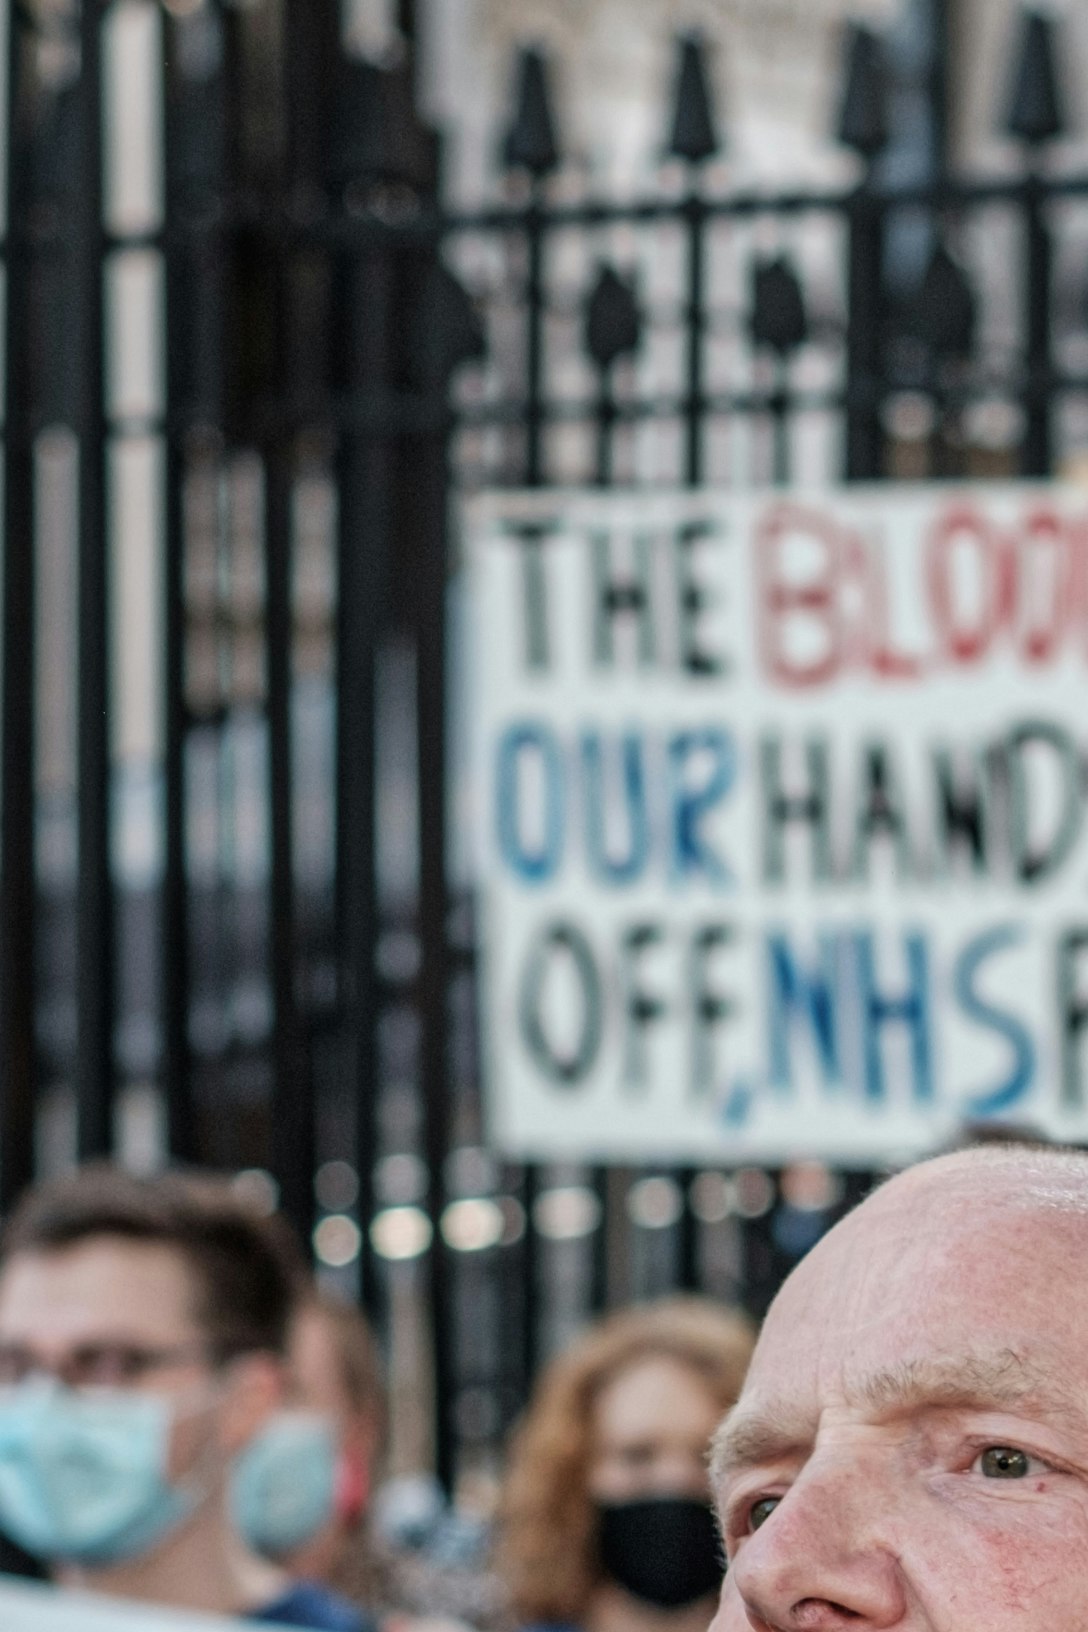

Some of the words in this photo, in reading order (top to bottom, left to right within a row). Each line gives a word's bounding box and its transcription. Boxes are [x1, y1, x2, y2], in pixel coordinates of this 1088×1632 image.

[500, 515, 730, 676] THE
[496, 722, 738, 884] OUR
[768, 922, 1037, 1116] NHS
